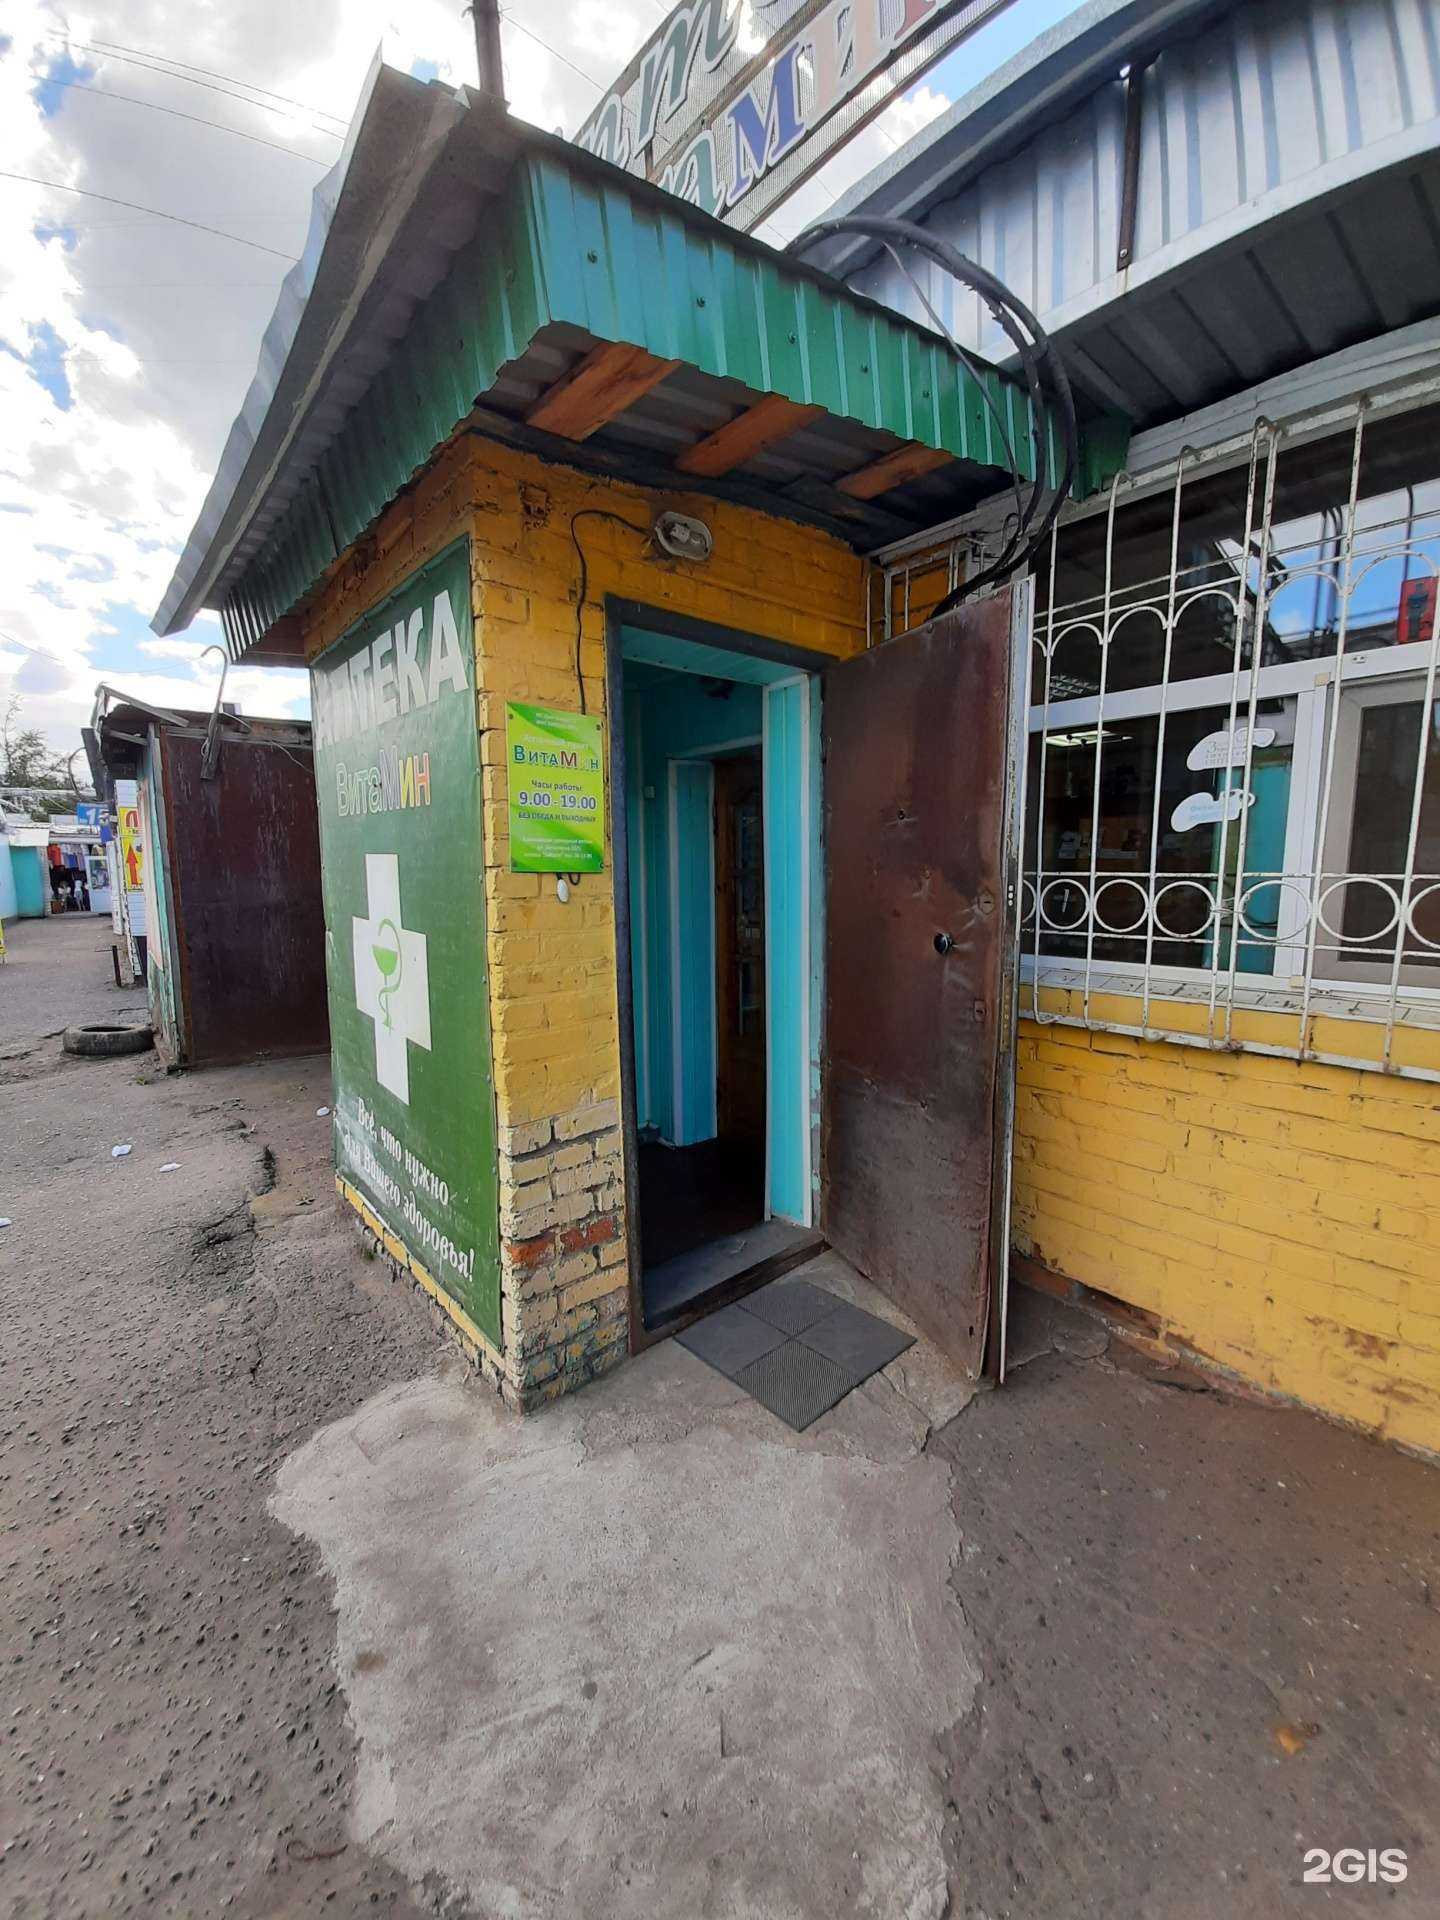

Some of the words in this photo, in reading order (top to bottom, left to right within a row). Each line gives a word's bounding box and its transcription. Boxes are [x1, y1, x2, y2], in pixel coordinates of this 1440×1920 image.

[313, 589, 469, 751] АПТЕКА
[519, 791, 551, 807] 9.00
[560, 793, 597, 811] 19.00
[380, 1125, 402, 1162] что
[405, 1149, 449, 1206] нужно
[403, 1190, 475, 1282] здоровья!
